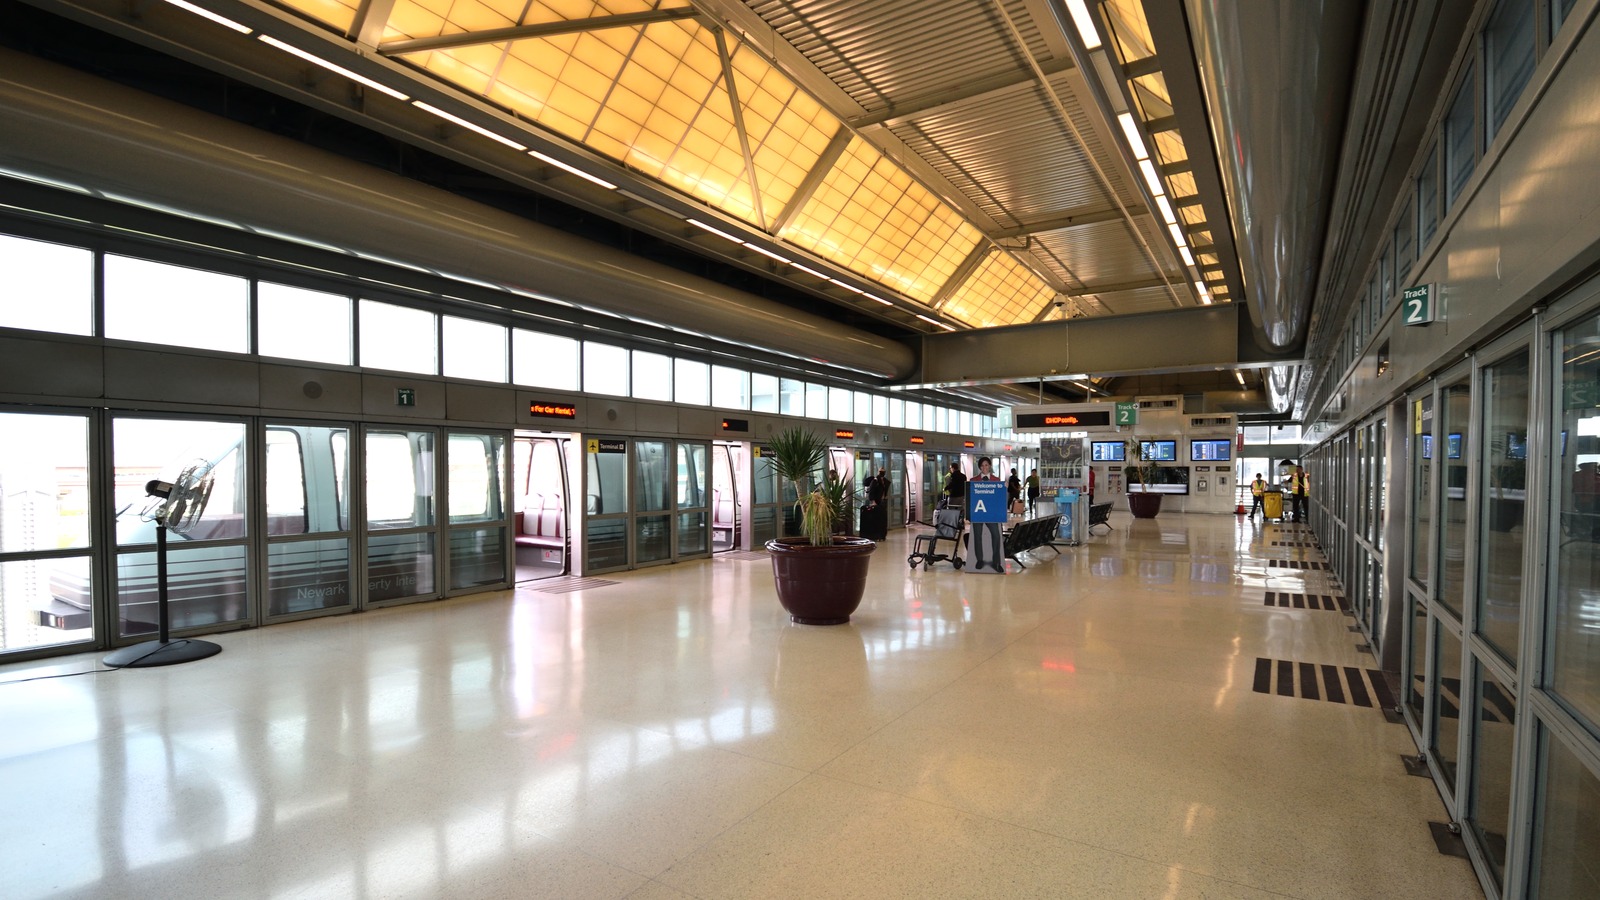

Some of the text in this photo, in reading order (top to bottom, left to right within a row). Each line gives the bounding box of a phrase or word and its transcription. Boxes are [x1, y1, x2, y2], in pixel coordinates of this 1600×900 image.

[1404, 287, 1427, 299] Track
[1407, 299, 1423, 323] 2
[401, 394, 407, 404] 1
[535, 405, 544, 413] For
[544, 405, 555, 414] Car
[1045, 416, 1061, 425] DHCP
[1120, 411, 1129, 422] 2
[974, 499, 987, 513] A
[297, 583, 345, 600] Newark
[368, 578, 391, 591] erty
